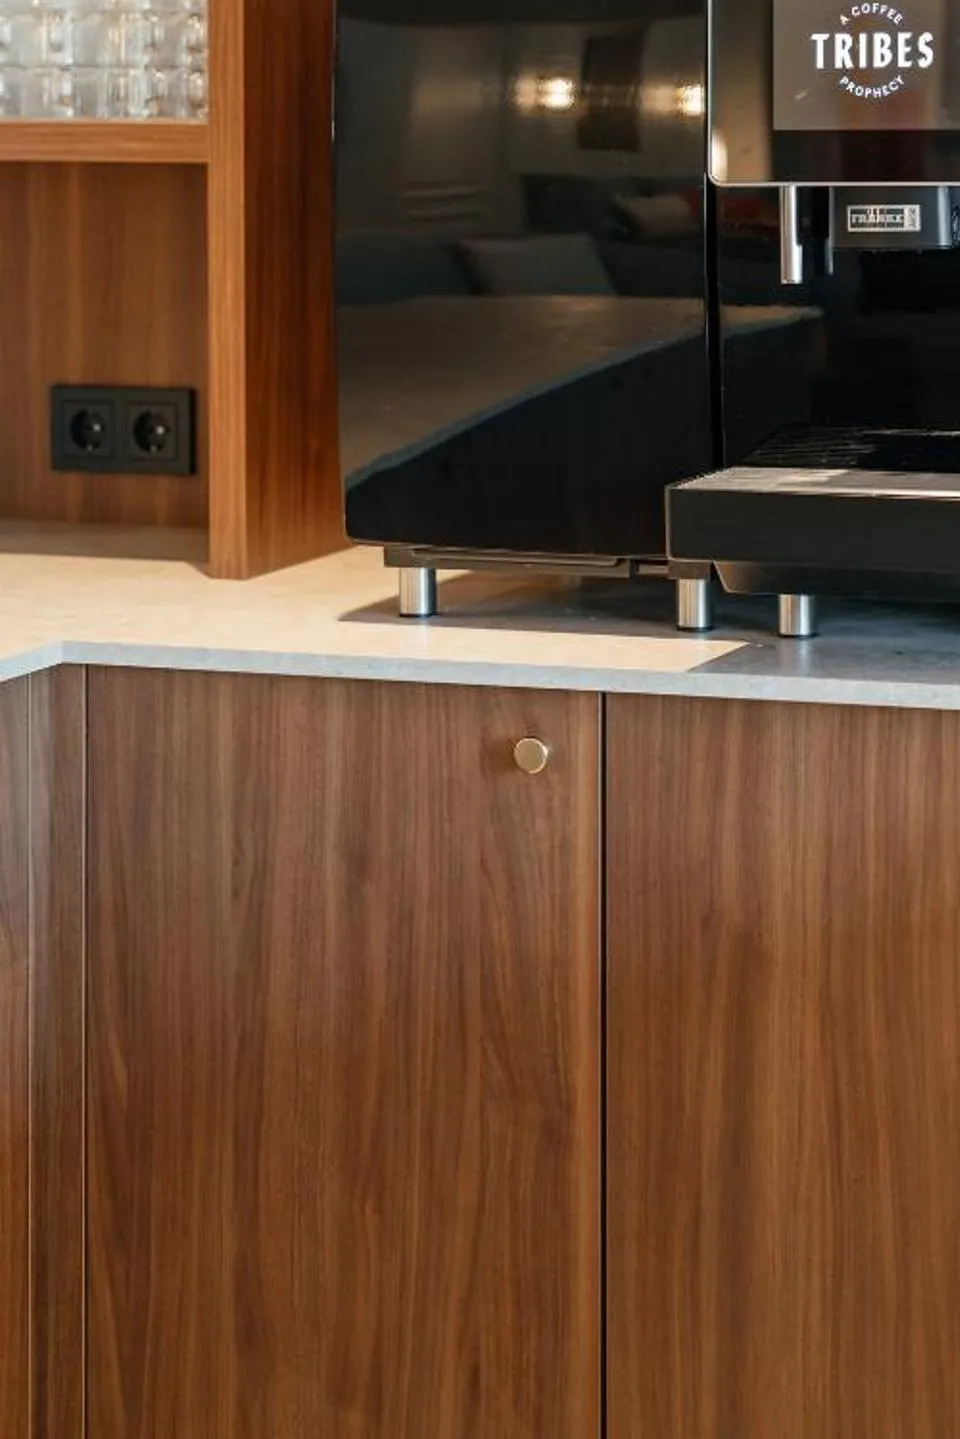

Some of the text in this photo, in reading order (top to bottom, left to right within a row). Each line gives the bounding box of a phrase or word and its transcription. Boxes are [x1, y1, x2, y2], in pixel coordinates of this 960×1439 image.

[839, 3, 904, 26] A COFFEE
[811, 32, 935, 69] TRIBES
[839, 75, 905, 99] PROPHECY
